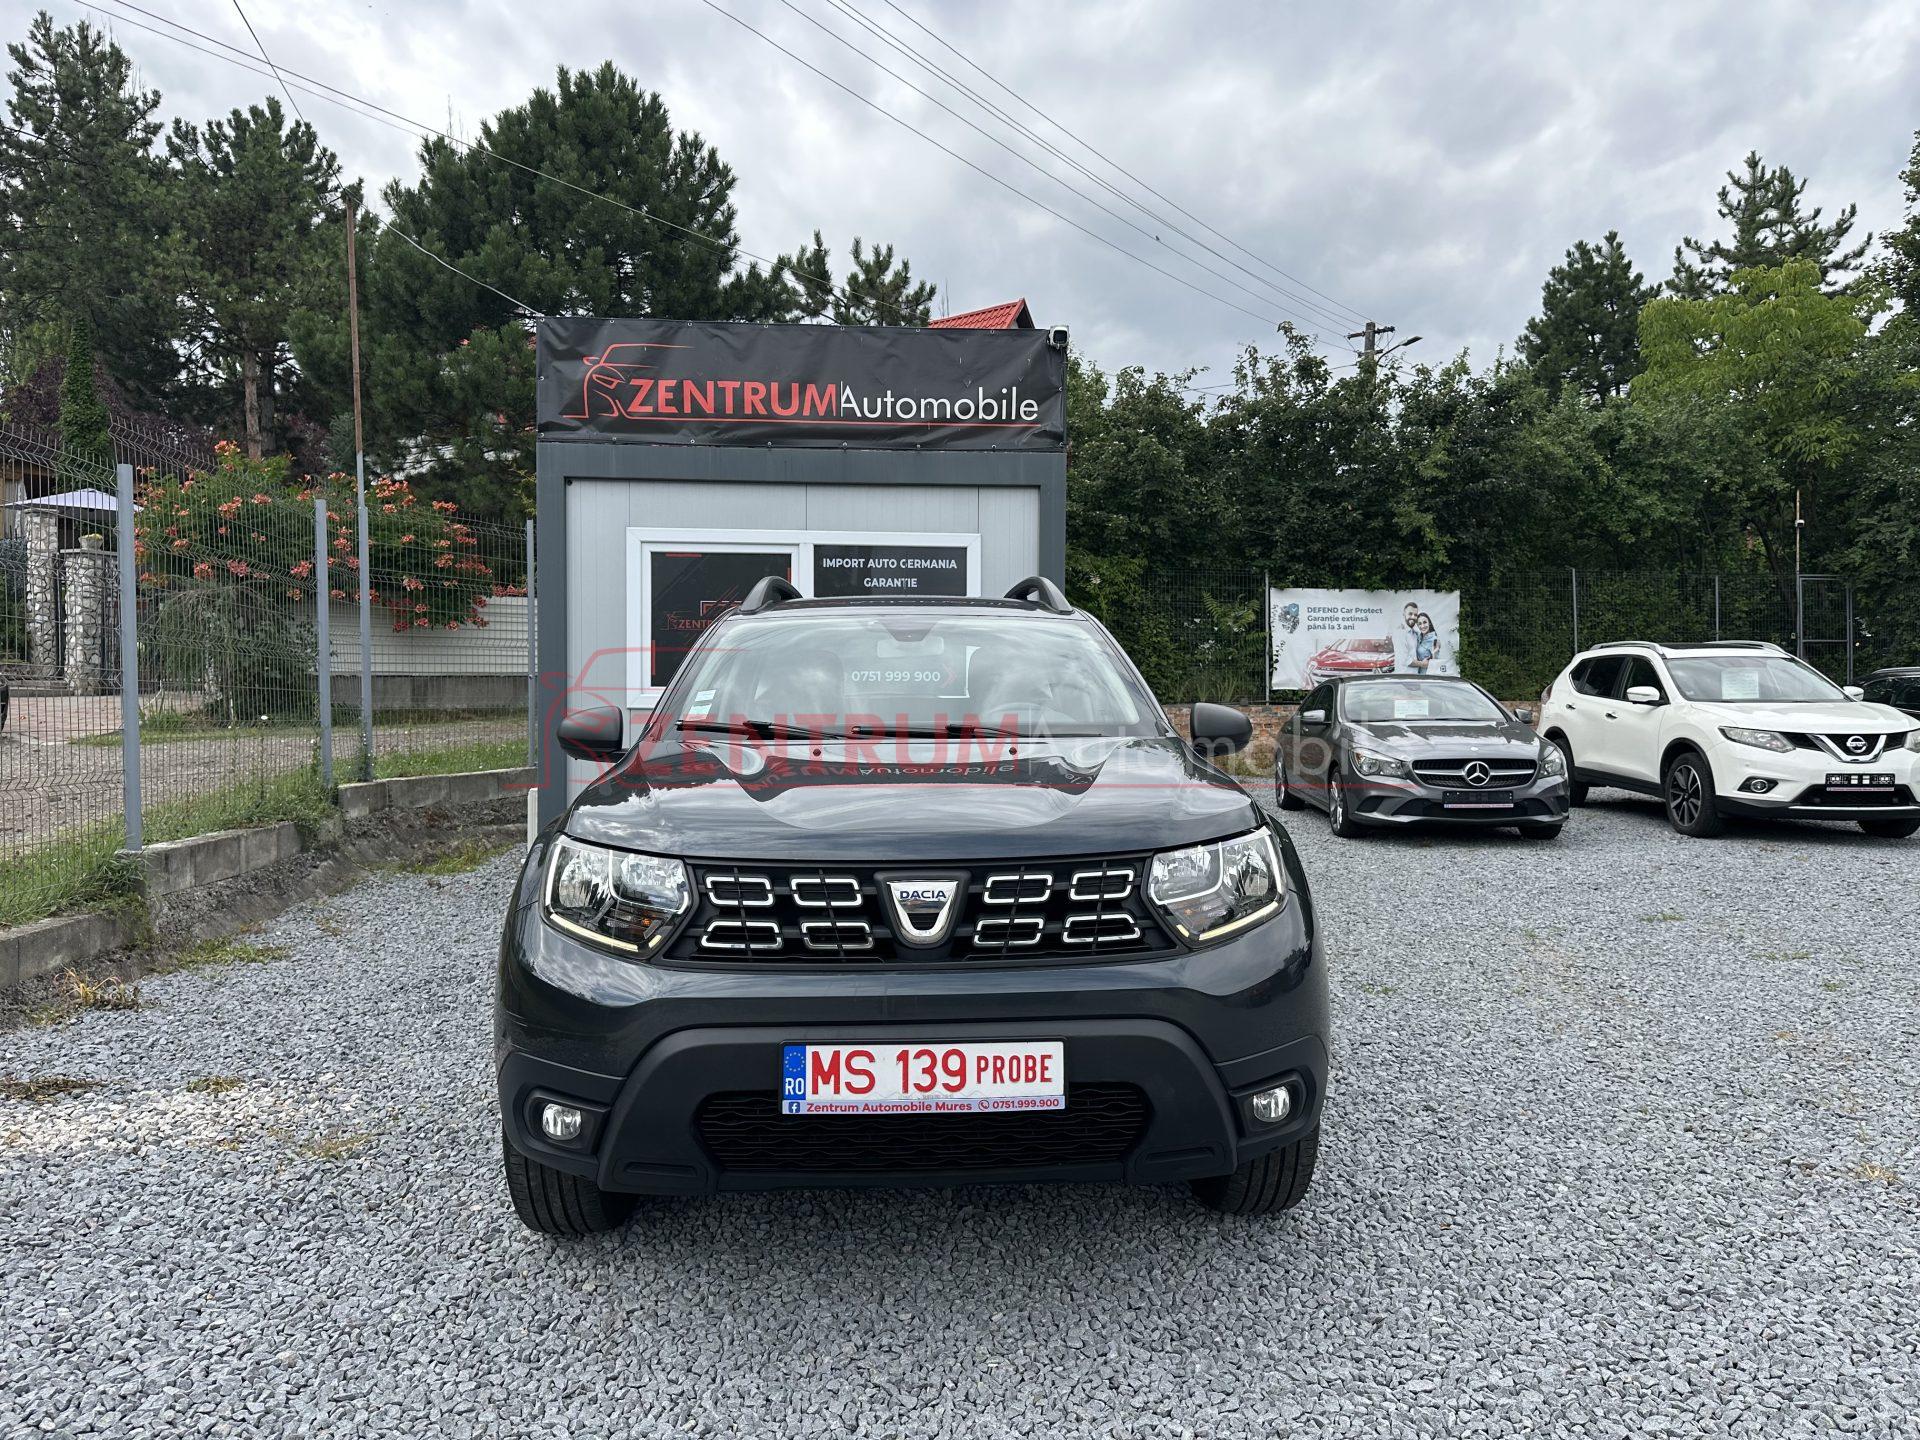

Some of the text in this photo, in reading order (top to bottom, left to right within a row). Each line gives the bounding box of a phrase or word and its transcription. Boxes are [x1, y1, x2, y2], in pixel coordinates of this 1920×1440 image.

[627, 379, 1039, 421] ZENTRUM Automobile
[822, 558, 865, 568] IMPORT
[867, 558, 897, 568] AUTO
[1306, 606, 1338, 614] DEFEND
[1355, 606, 1383, 614] Protect
[851, 671, 941, 681] 0751 999 900
[899, 889, 947, 899] DACIA
[810, 1049, 1053, 1095] MS 139 PROBE
[785, 1077, 805, 1096] RO
[806, 1098, 1060, 1113] Zentrum Automobile Mures 0751.999.900
